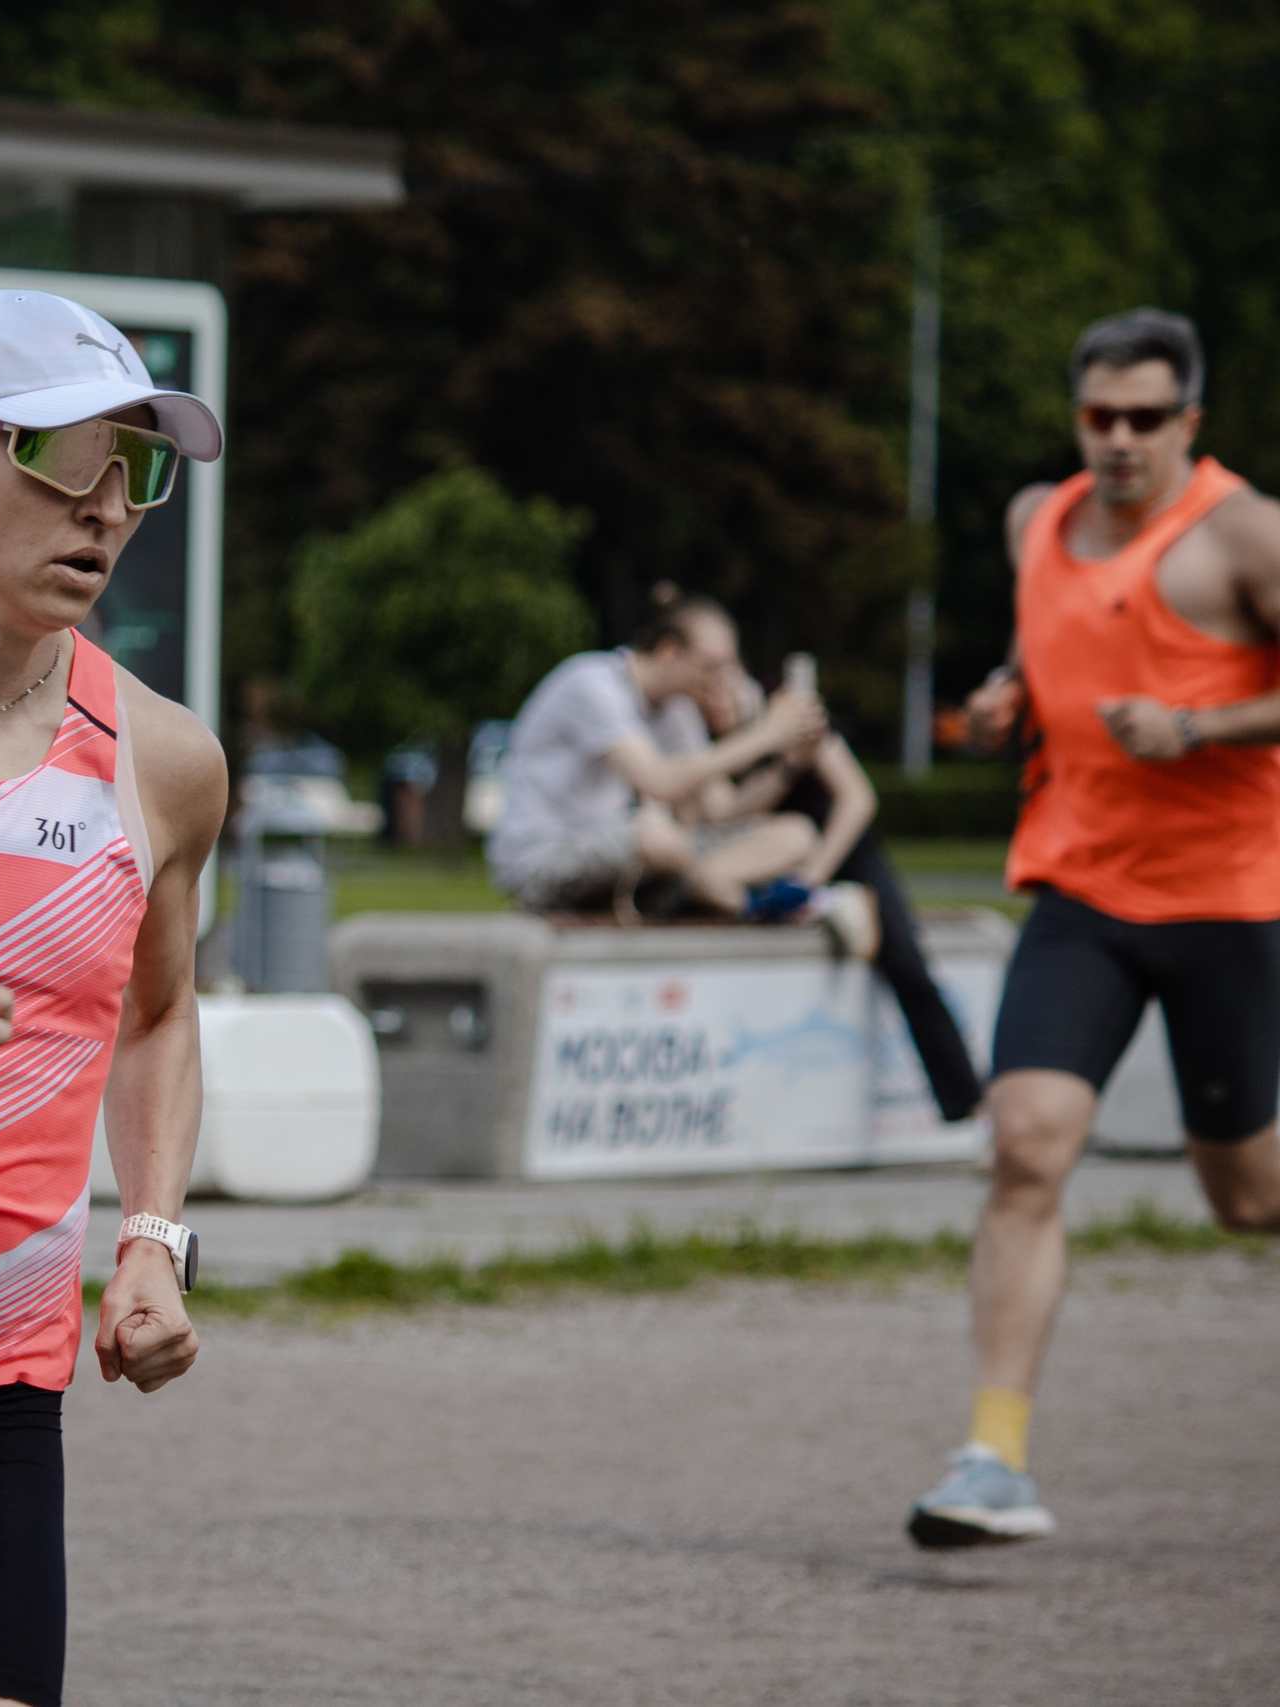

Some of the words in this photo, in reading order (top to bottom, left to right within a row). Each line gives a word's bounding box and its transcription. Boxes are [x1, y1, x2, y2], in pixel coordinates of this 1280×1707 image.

[34, 816, 87, 853] 361°
[555, 1024, 711, 1084] МОСКВА
[546, 1096, 597, 1146] НА
[605, 1087, 738, 1148] ВОЛНЕ
